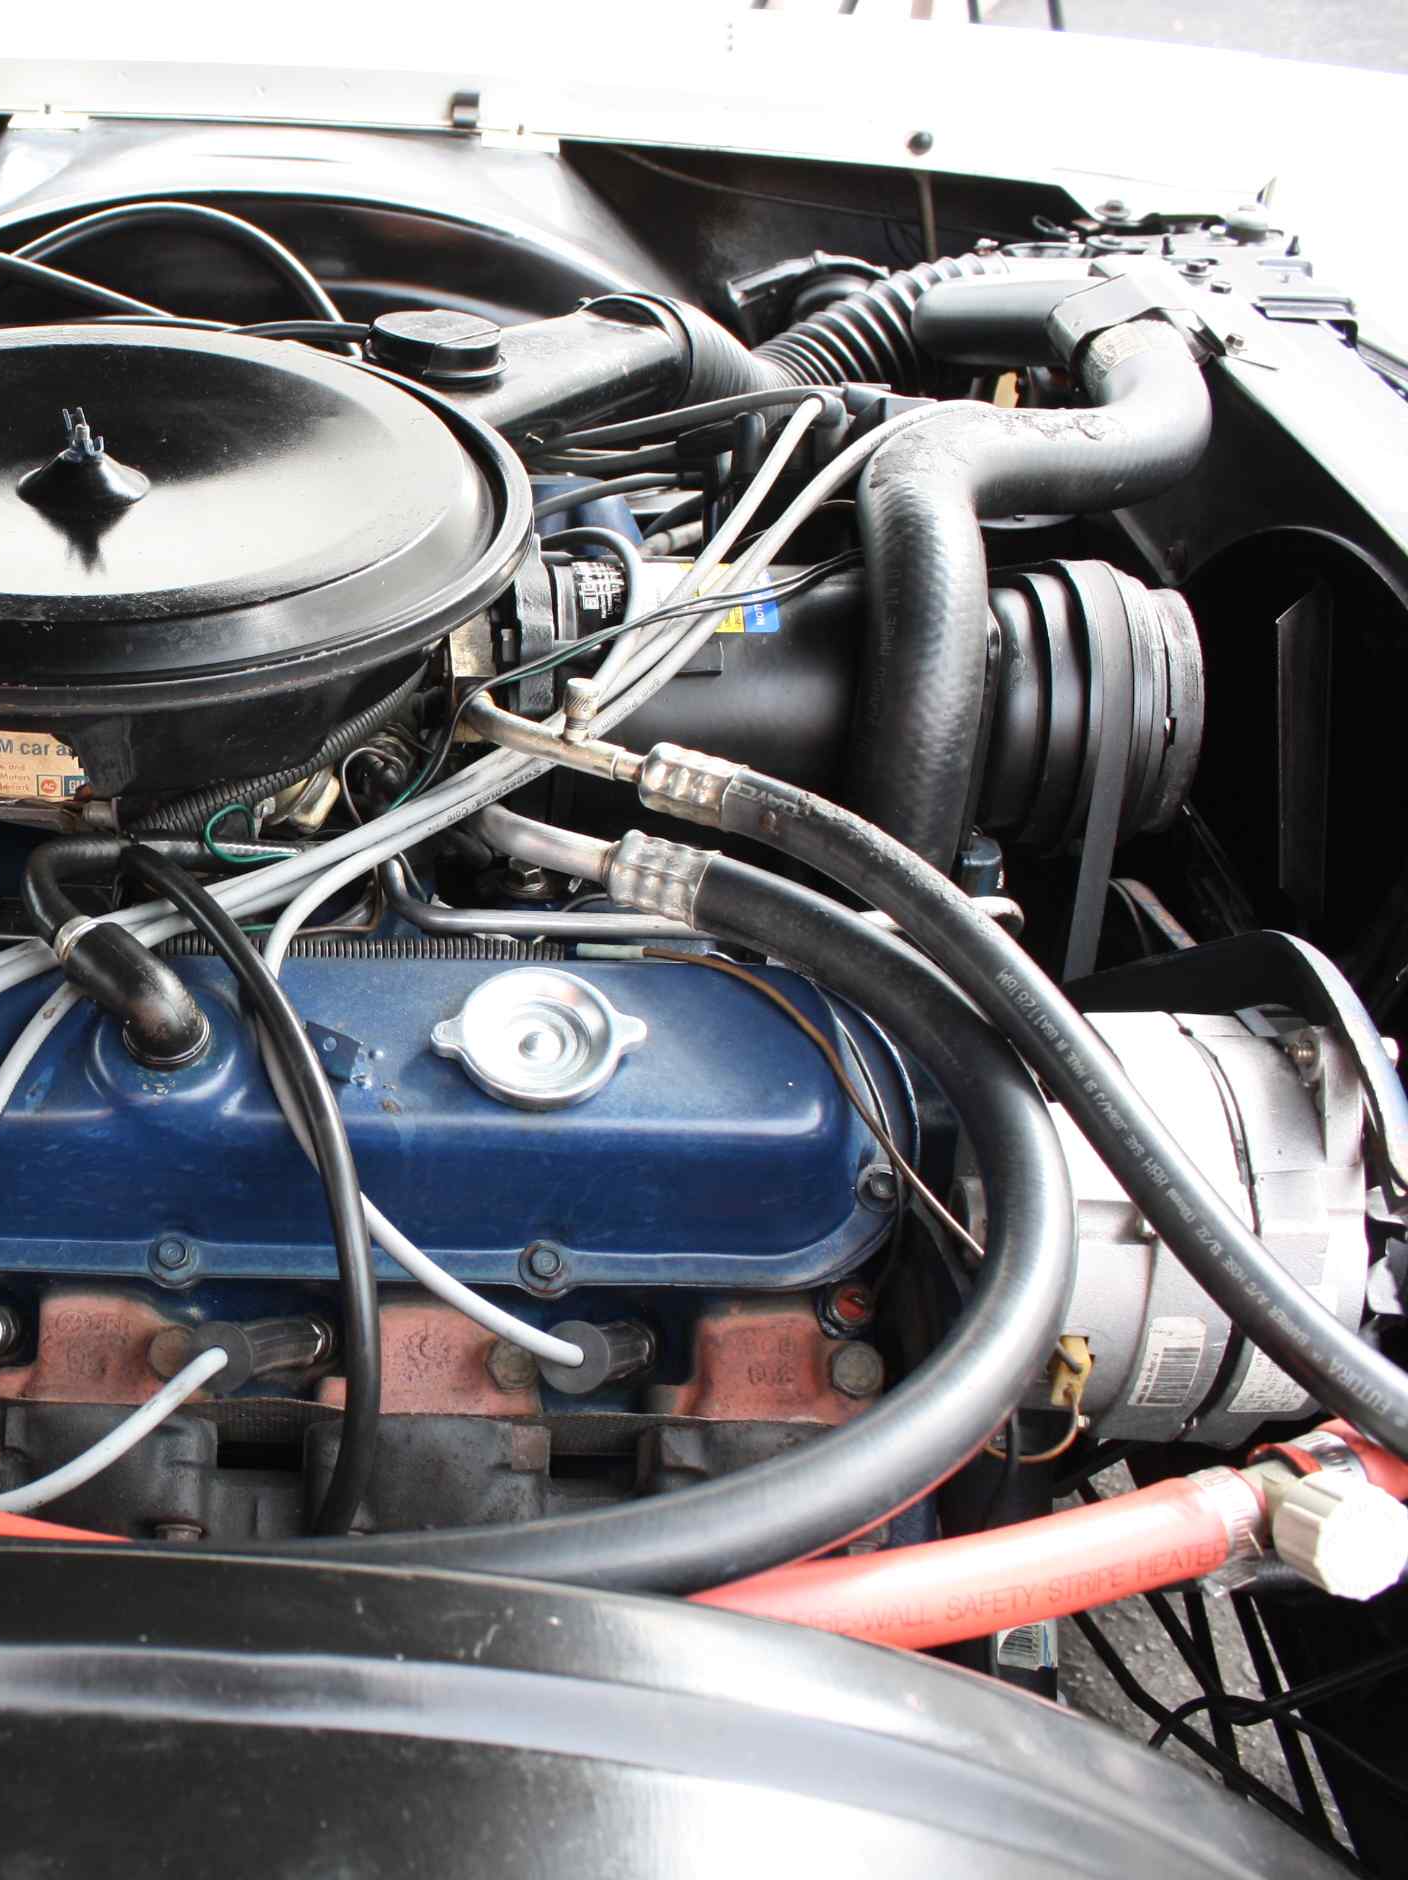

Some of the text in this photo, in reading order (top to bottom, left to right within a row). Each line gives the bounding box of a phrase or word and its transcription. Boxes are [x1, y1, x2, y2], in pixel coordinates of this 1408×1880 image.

[20, 741, 49, 755] car
[940, 1580, 1036, 1623] SAFETY
[1044, 1560, 1126, 1605] STRIPE
[1133, 1537, 1232, 1583] HEATER
